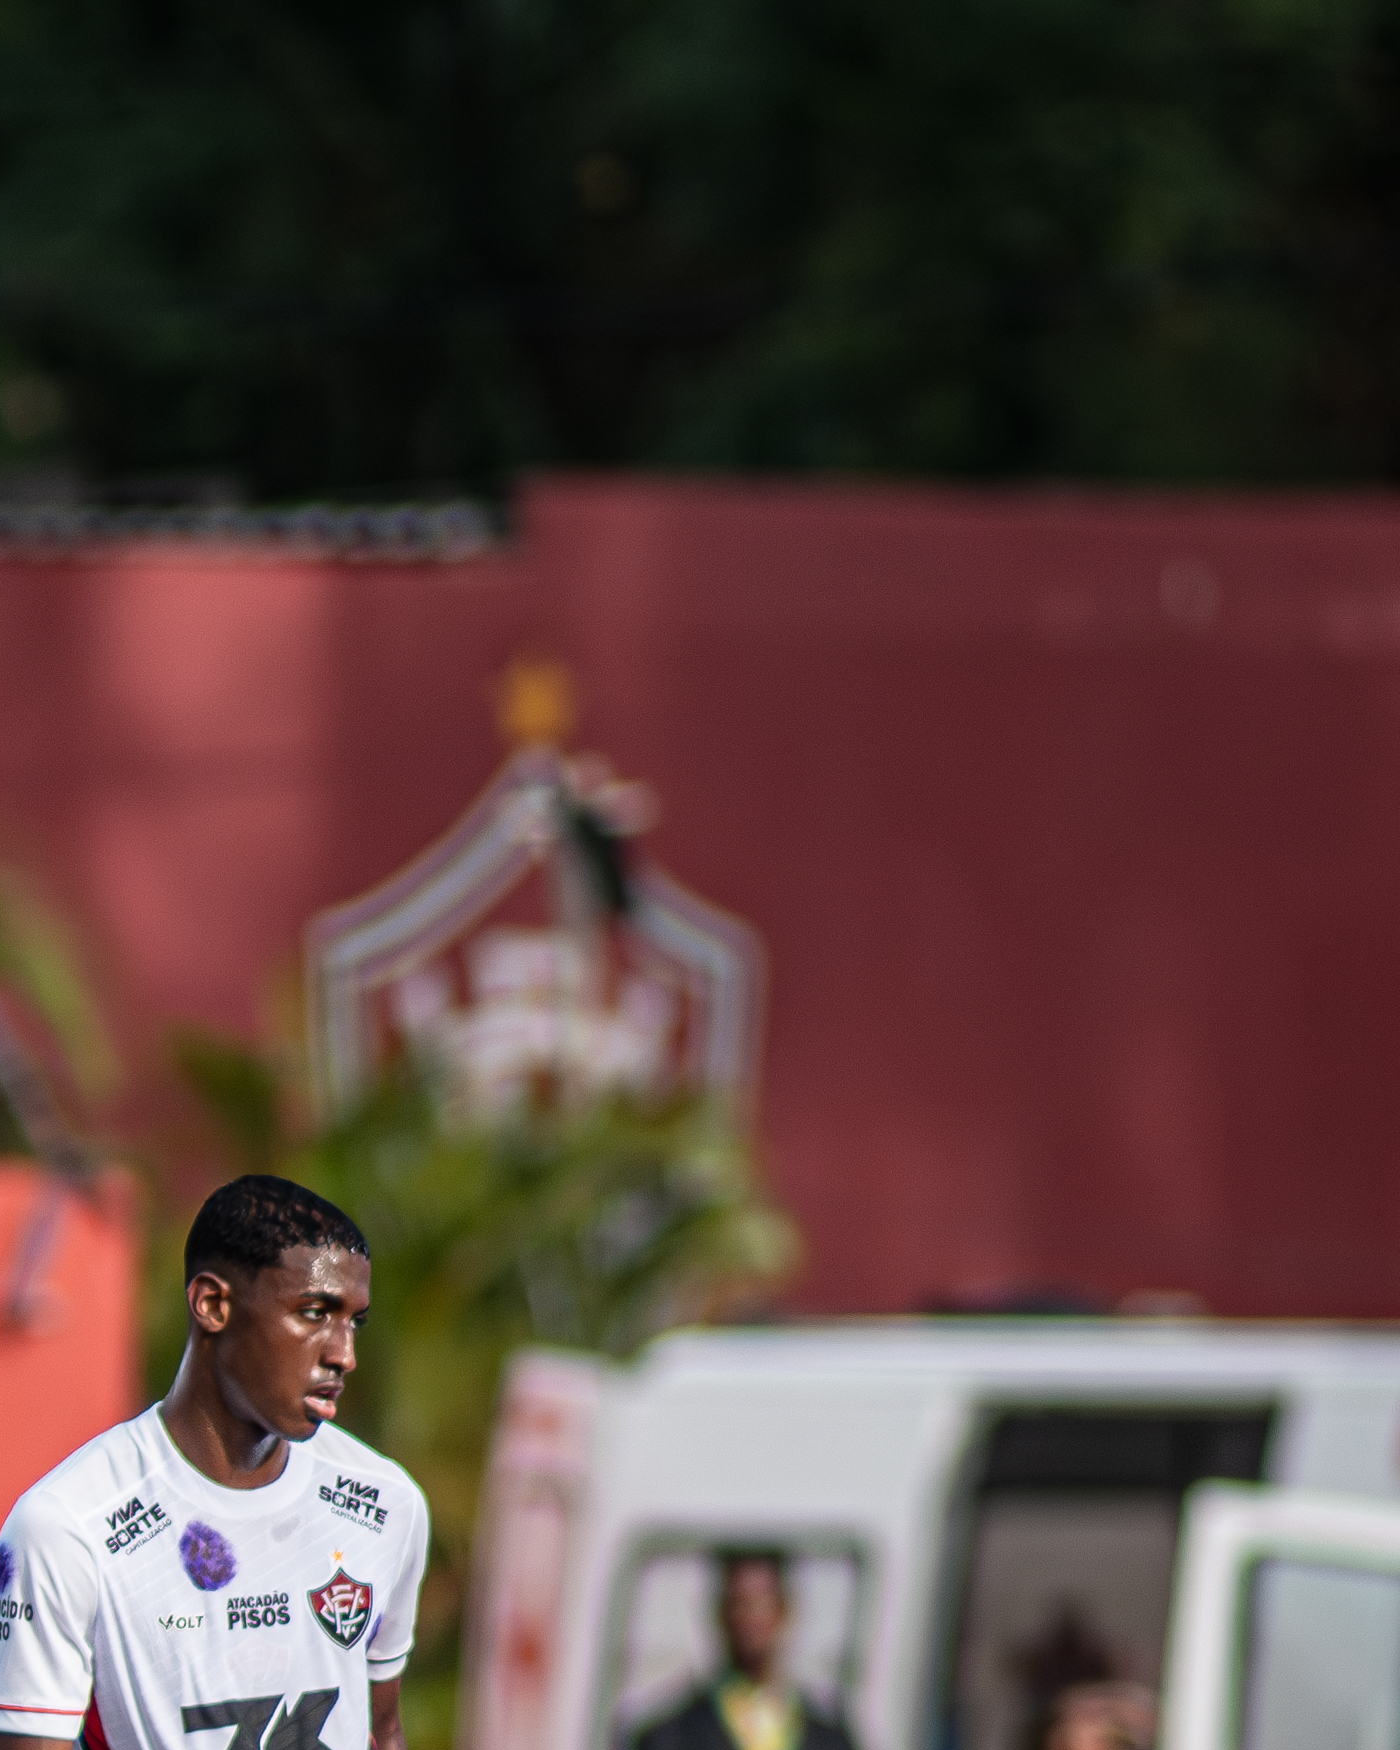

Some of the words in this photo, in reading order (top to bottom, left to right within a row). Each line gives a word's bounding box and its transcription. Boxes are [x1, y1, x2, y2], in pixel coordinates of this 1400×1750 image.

[318, 1485, 388, 1526] SORTE
[335, 1475, 380, 1504] VIVA
[105, 1496, 144, 1531] VIVA
[105, 1502, 167, 1554] SORTE
[226, 1591, 289, 1610] ATACADÃO
[227, 1605, 291, 1630] PISOS
